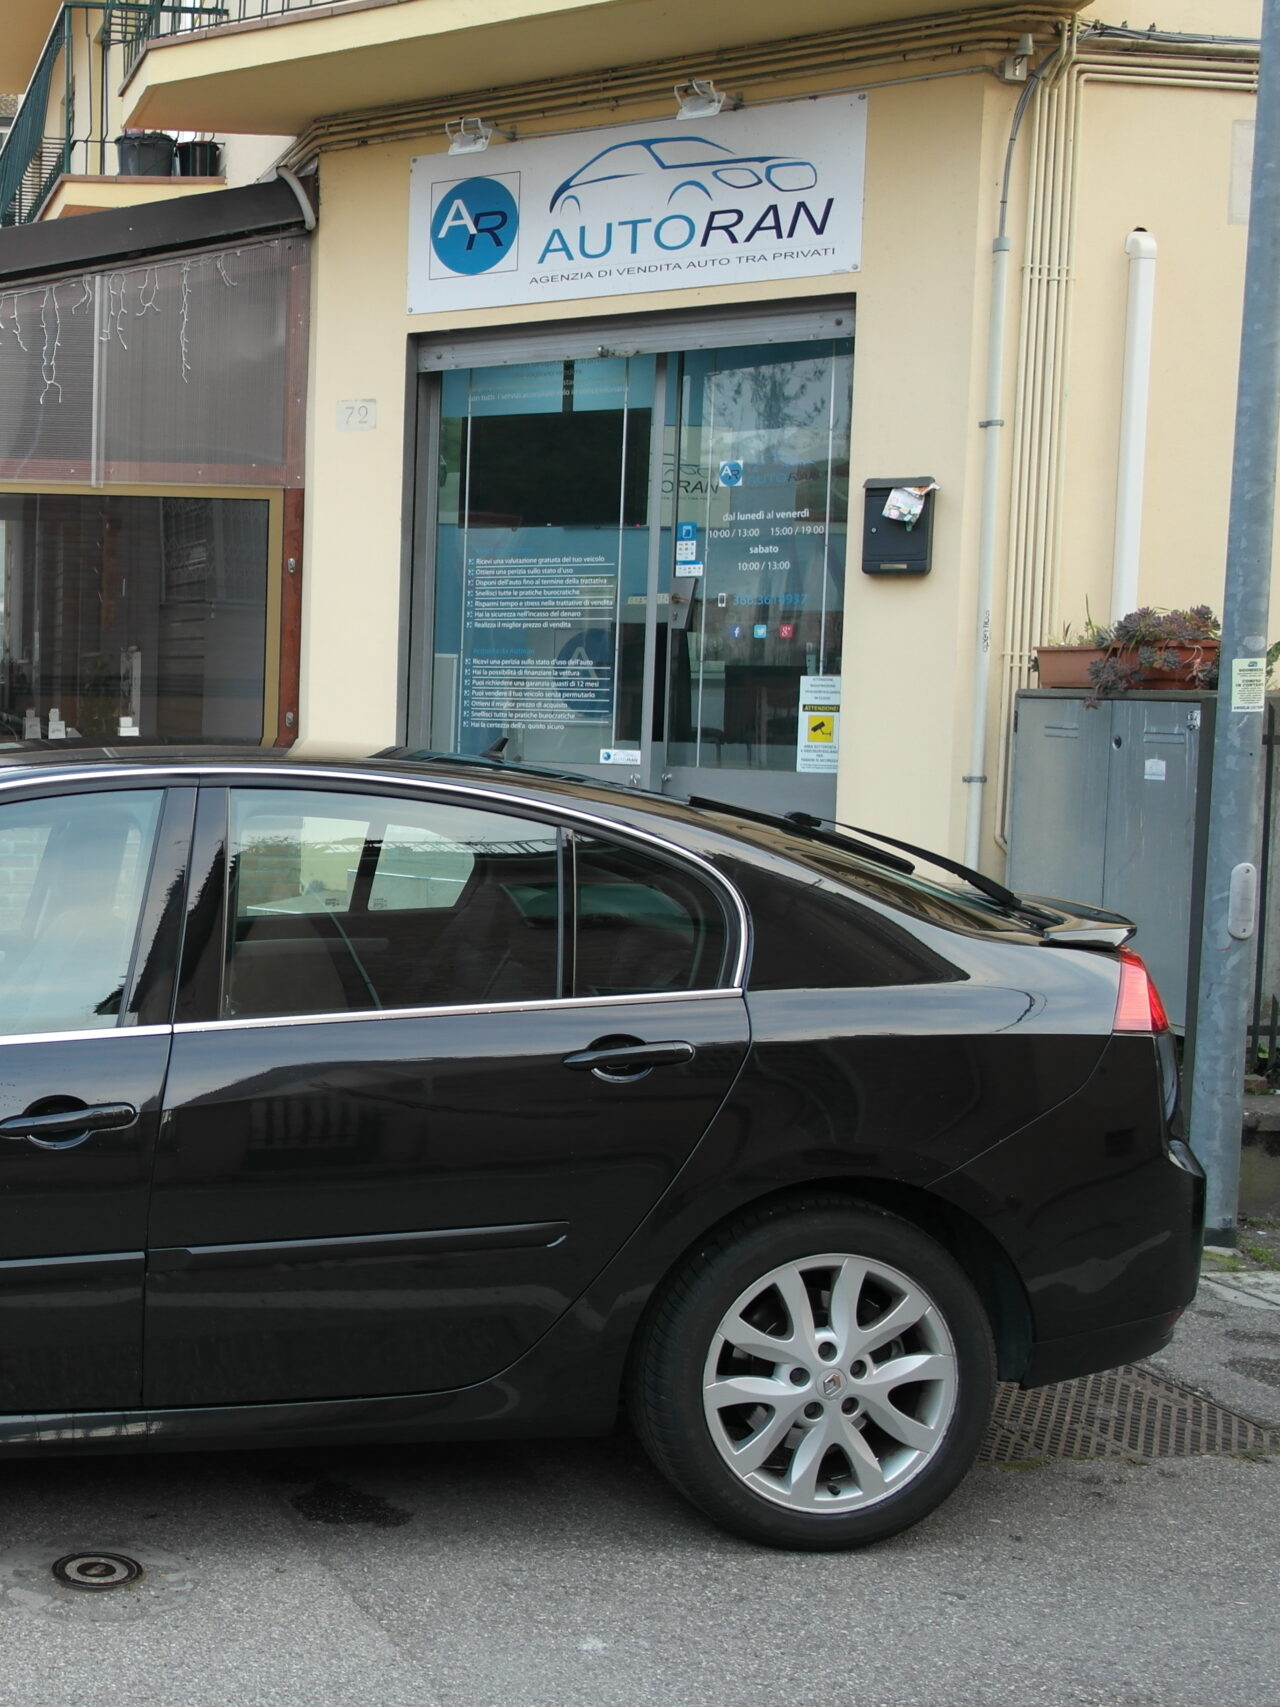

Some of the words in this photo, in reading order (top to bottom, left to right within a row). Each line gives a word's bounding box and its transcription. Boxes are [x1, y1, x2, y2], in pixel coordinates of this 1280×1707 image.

[537, 197, 835, 265] AUTORAN
[529, 271, 594, 285] AGENZIA
[597, 268, 613, 278] DI
[616, 262, 683, 276] VENDITA
[686, 257, 731, 269] AUTO
[735, 254, 768, 263] TRA
[772, 246, 836, 261] PRIVATI
[345, 405, 369, 425] 72
[722, 511, 736, 521] dal
[766, 509, 774, 519] al
[738, 528, 760, 537] 13:00
[771, 527, 793, 536] 15:00
[749, 544, 779, 554] sabato
[738, 562, 760, 571] 10:00
[768, 560, 791, 570] 13:00
